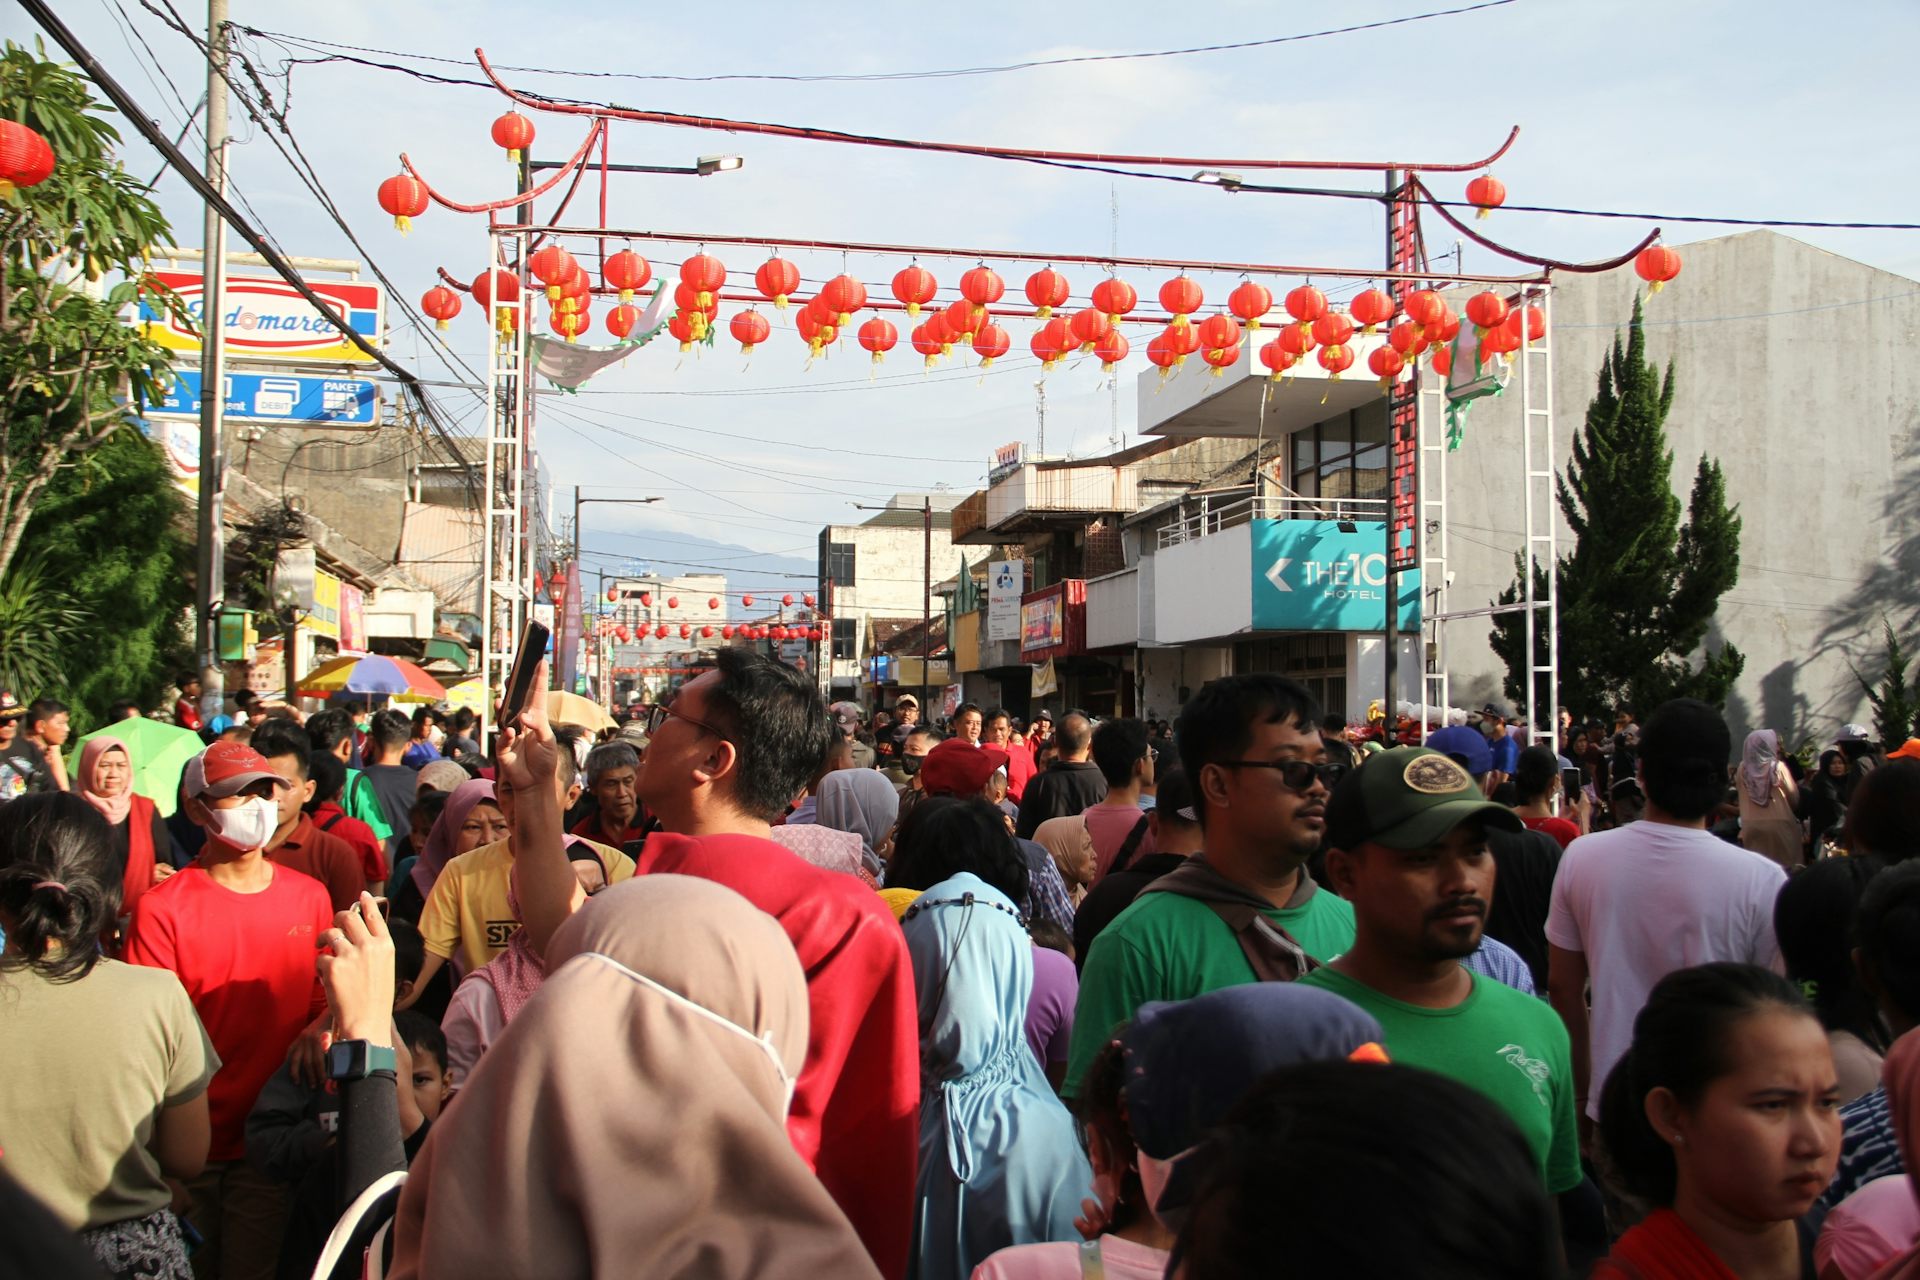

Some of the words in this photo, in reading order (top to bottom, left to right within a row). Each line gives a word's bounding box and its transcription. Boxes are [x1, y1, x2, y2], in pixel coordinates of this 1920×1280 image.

[323, 382, 362, 392] PAKET
[192, 401, 246, 411] pent
[261, 402, 289, 410] DEBIT
[1324, 590, 1382, 600] HOTEL
